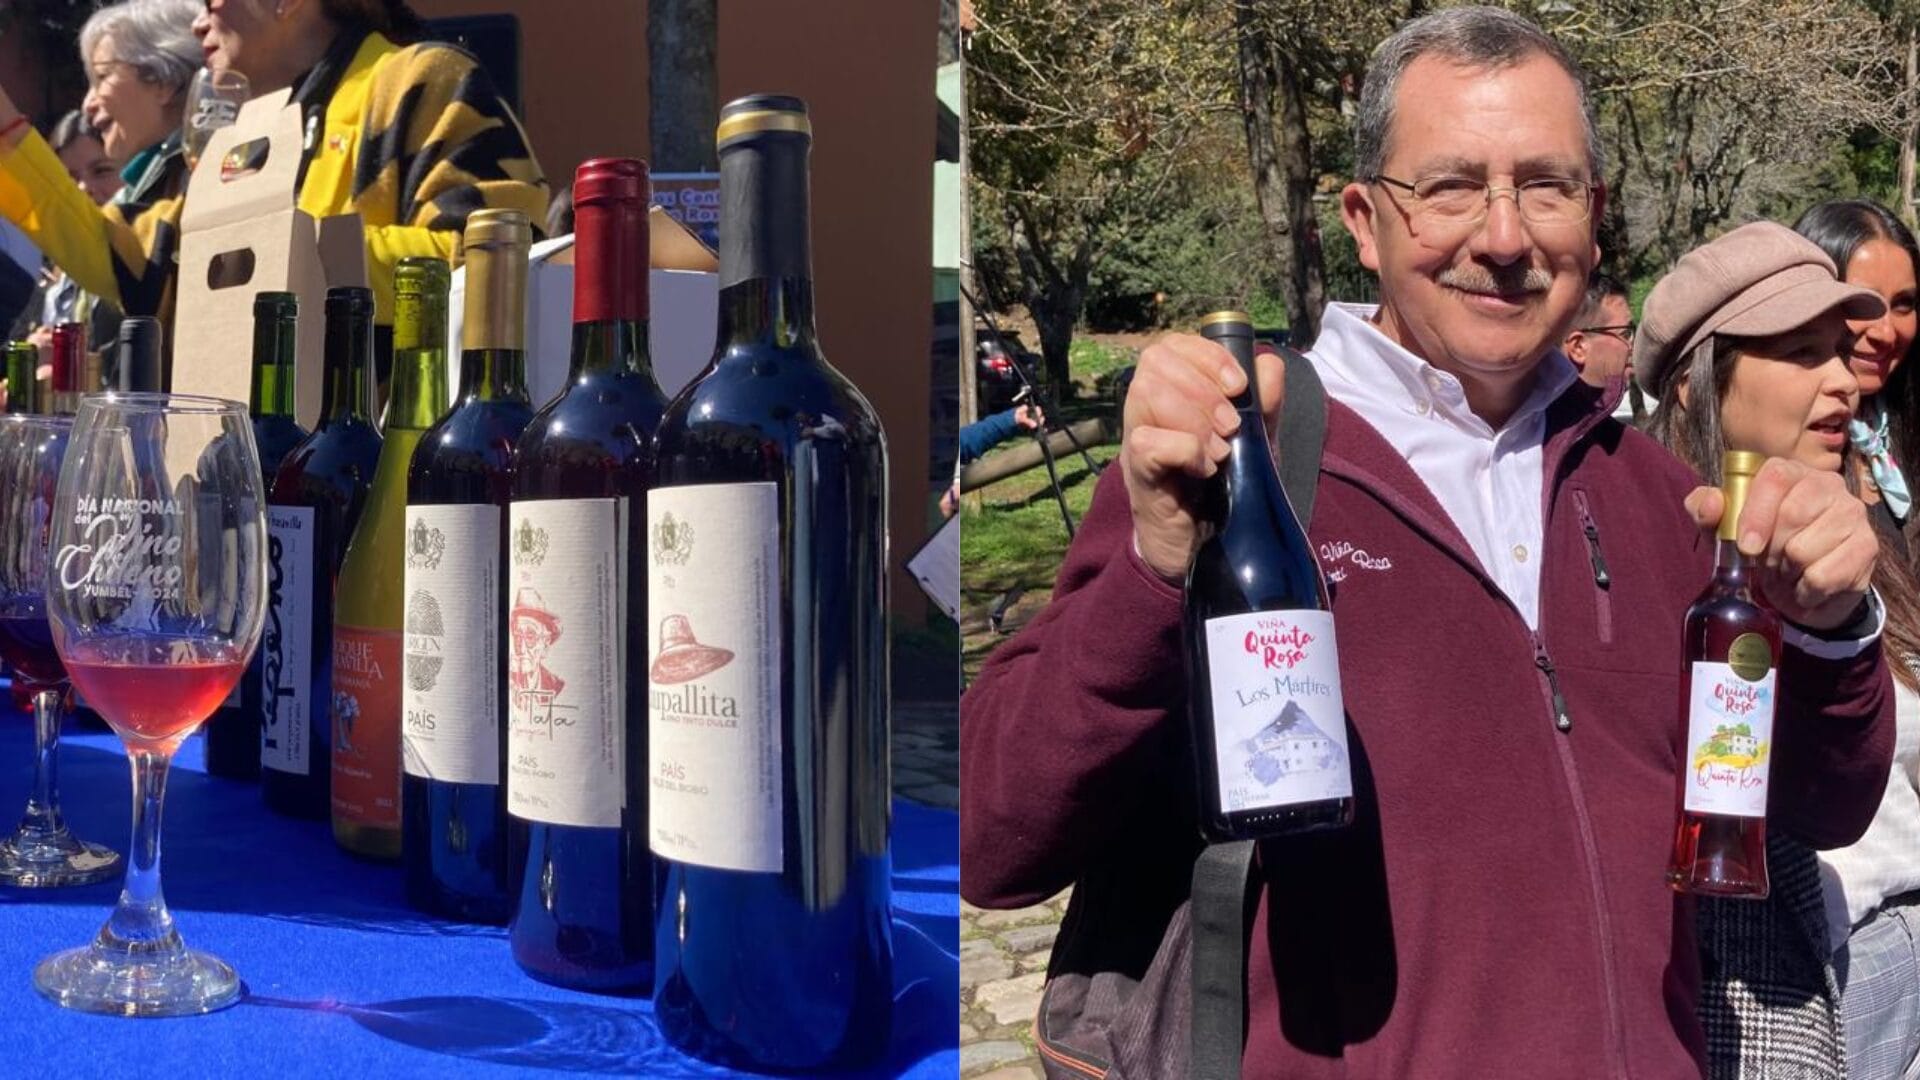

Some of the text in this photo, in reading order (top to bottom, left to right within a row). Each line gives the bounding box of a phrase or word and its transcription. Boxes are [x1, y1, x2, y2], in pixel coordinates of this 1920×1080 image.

[1258, 618, 1287, 629] VIÑA
[1245, 625, 1315, 654] Quinta
[1264, 646, 1308, 668] Rosa
[1236, 687, 1271, 708] Los
[1714, 683, 1760, 702] Quinta
[1726, 696, 1757, 715] Rosa
[408, 708, 436, 730] PAÍS
